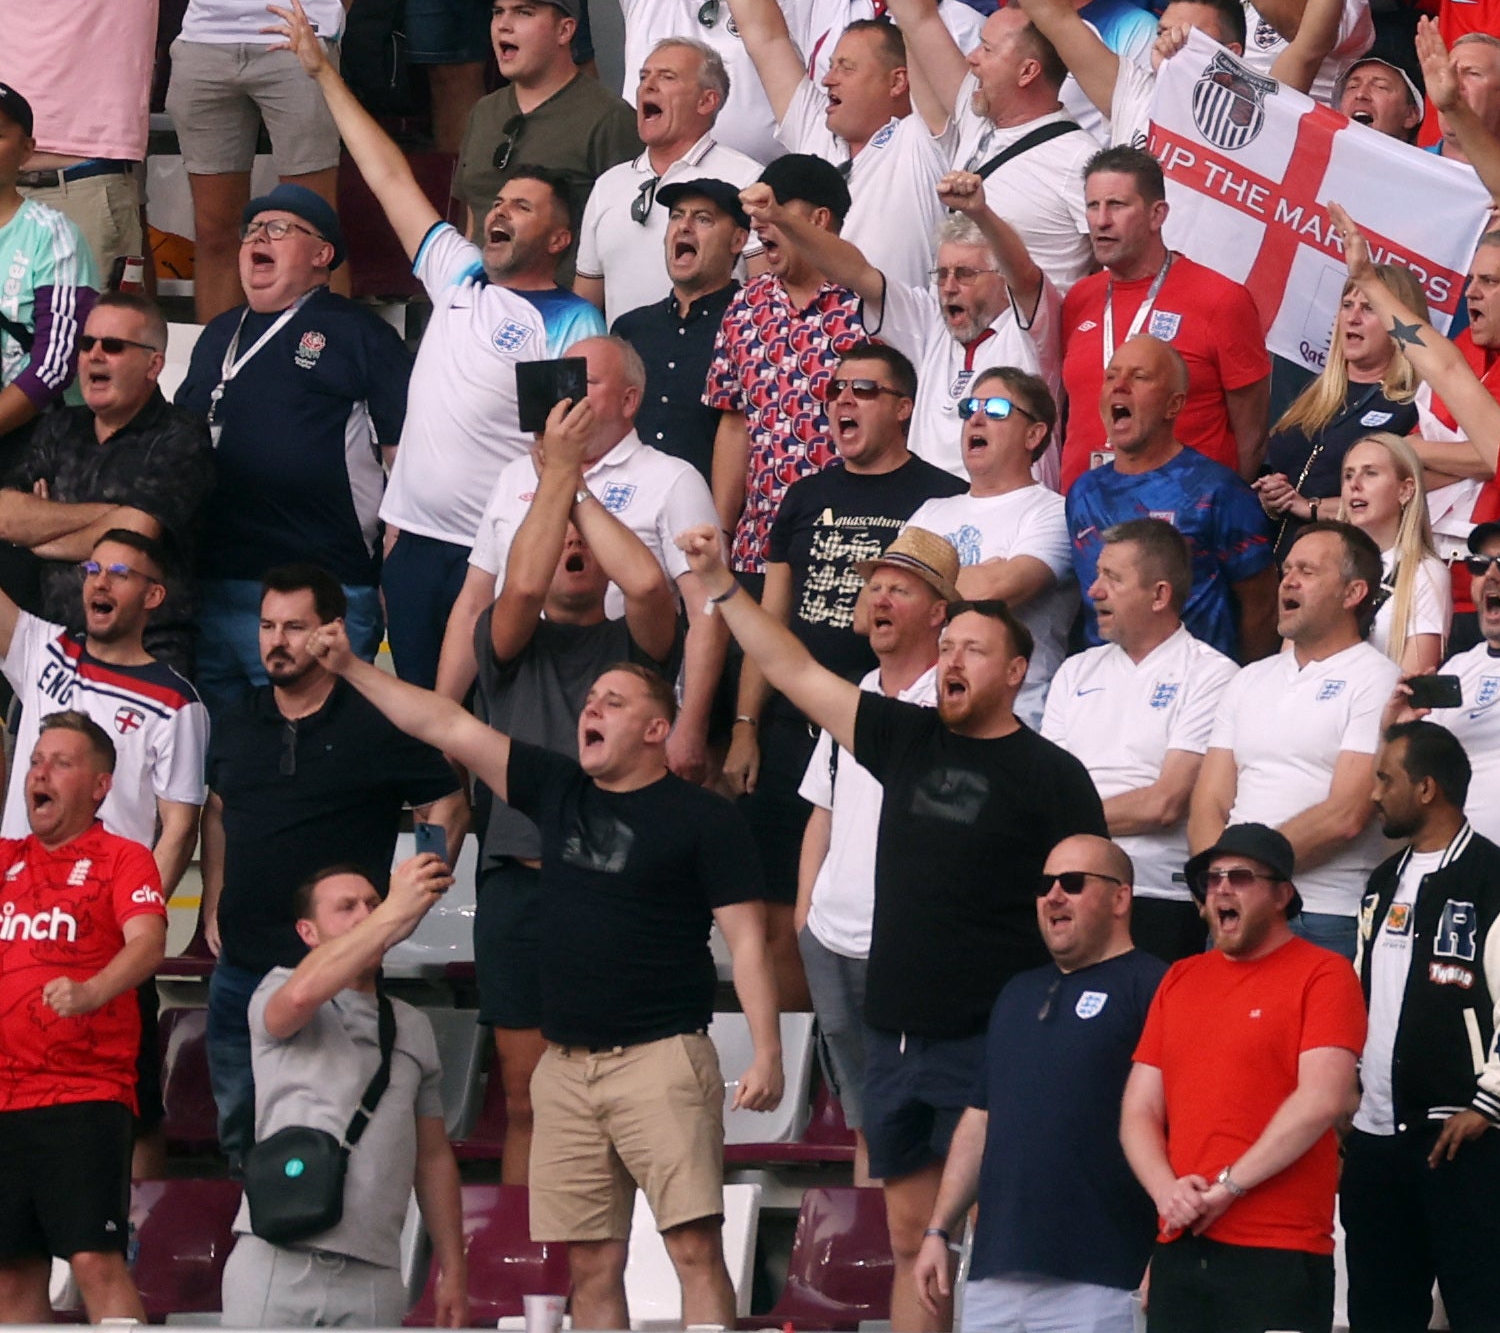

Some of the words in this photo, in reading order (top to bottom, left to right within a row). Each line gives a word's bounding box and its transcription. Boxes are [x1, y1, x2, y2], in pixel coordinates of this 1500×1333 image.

[1150, 136, 1196, 171] UP
[1203, 158, 1266, 215] THE
[1275, 203, 1453, 303] MARNERS
[1432, 898, 1477, 962] R
